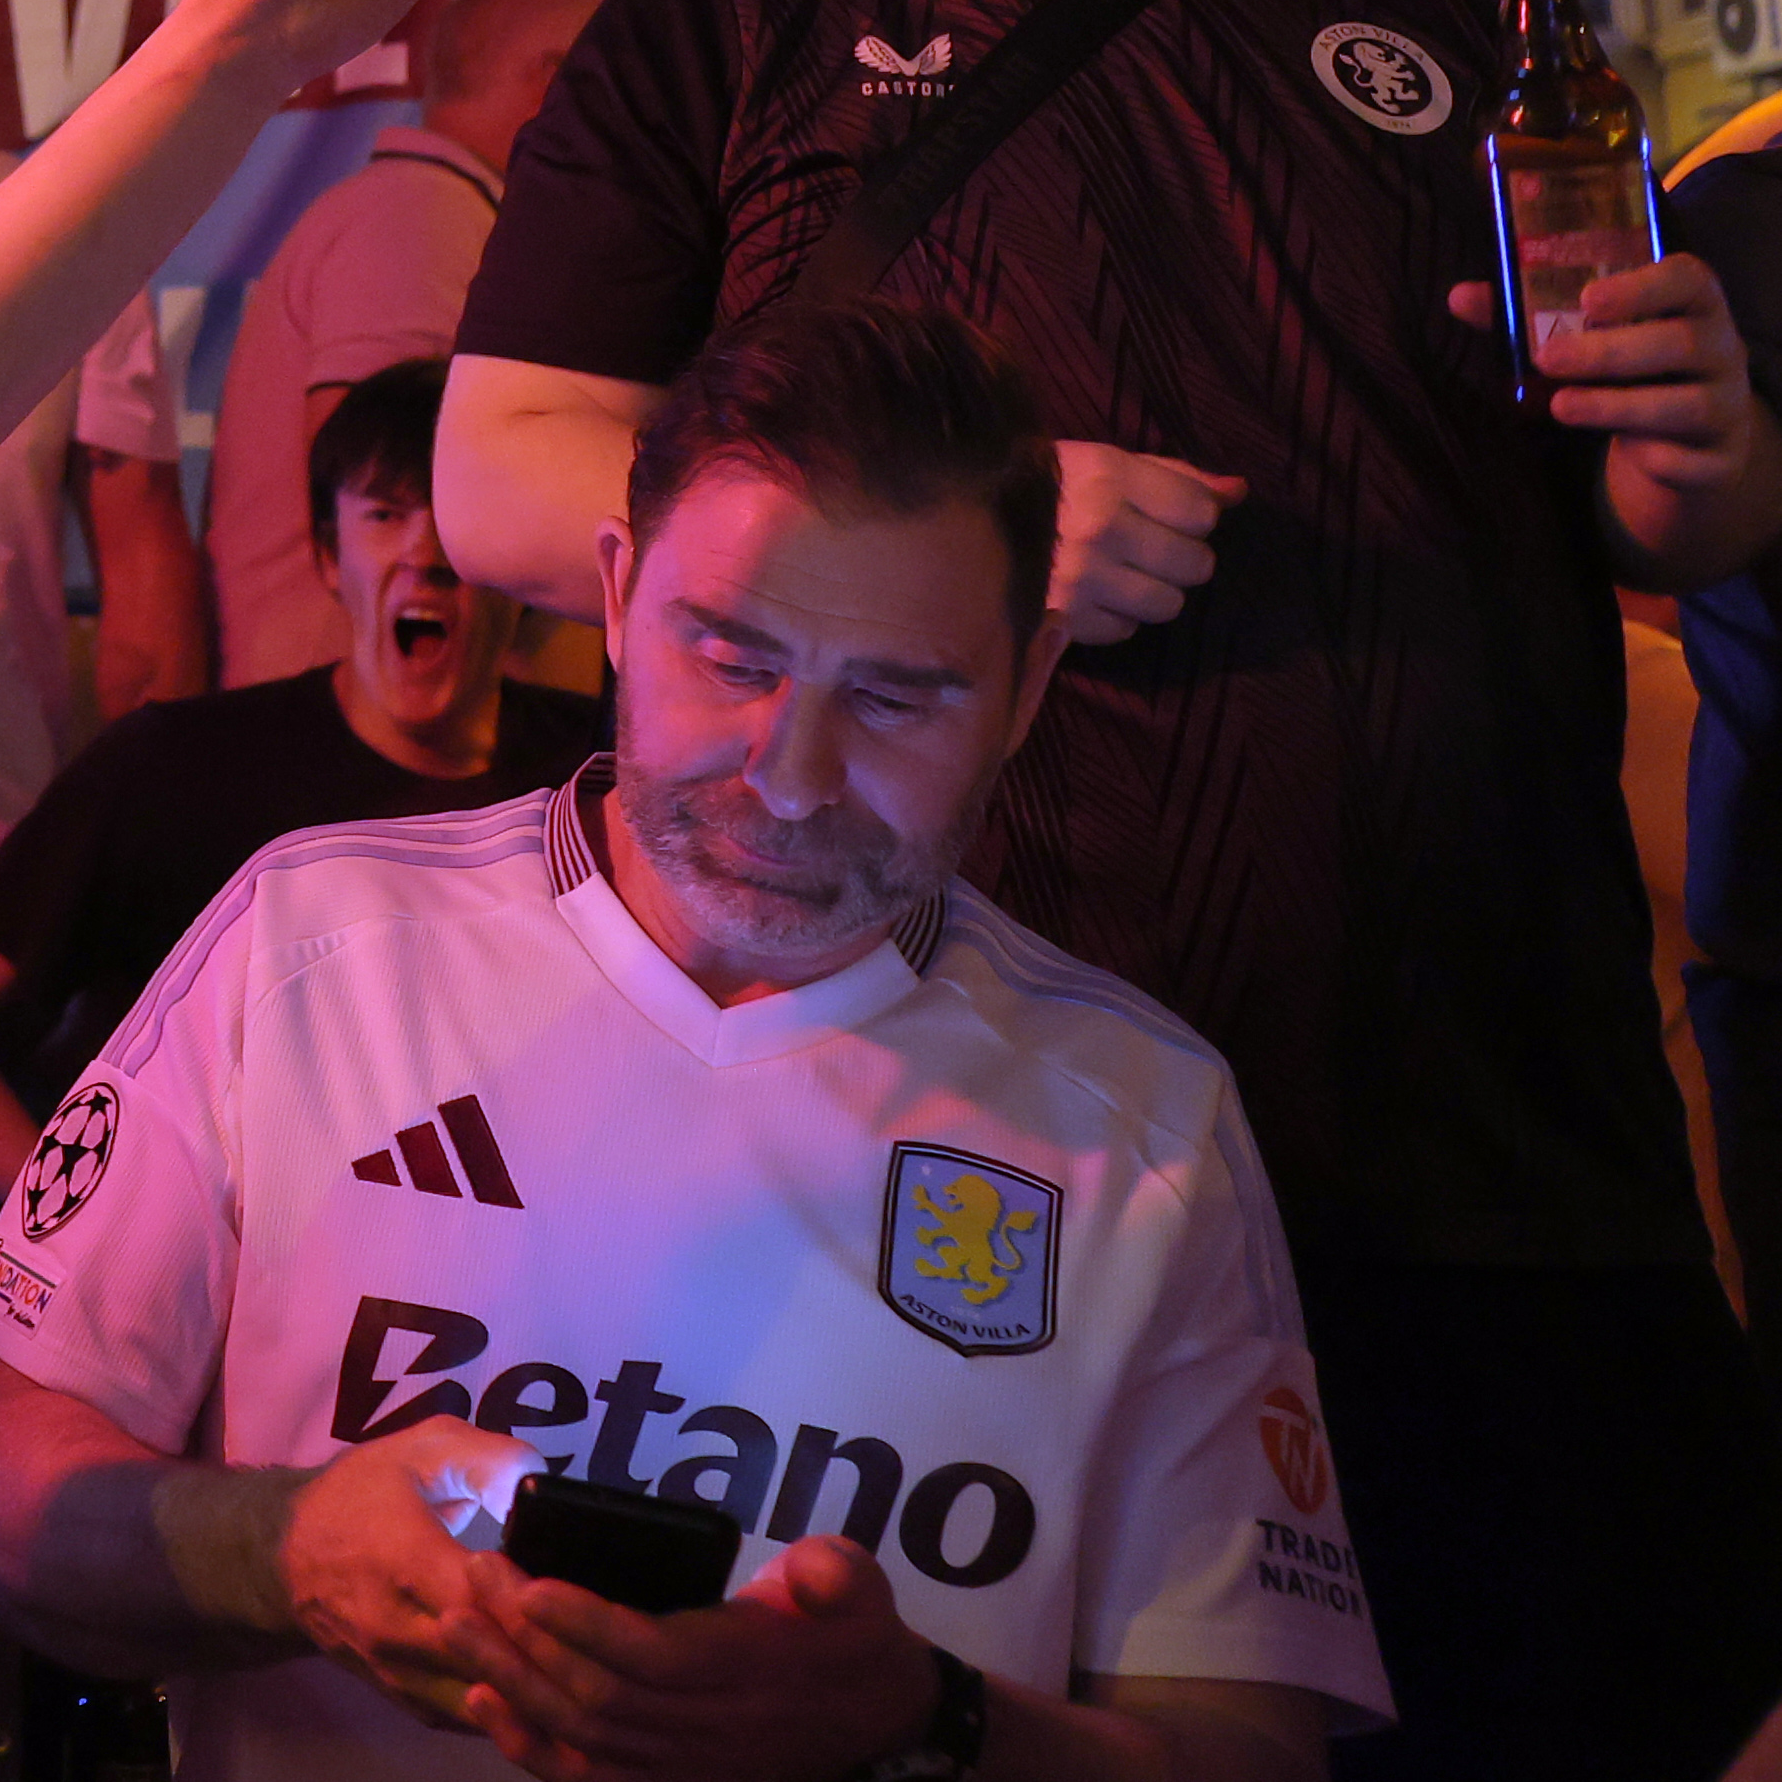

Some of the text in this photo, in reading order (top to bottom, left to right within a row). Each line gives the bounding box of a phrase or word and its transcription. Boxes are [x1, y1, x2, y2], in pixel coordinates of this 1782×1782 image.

[898, 1293, 968, 1335] ASTON
[972, 1323, 1031, 1339] VILLA
[329, 1294, 1036, 1589] Betano
